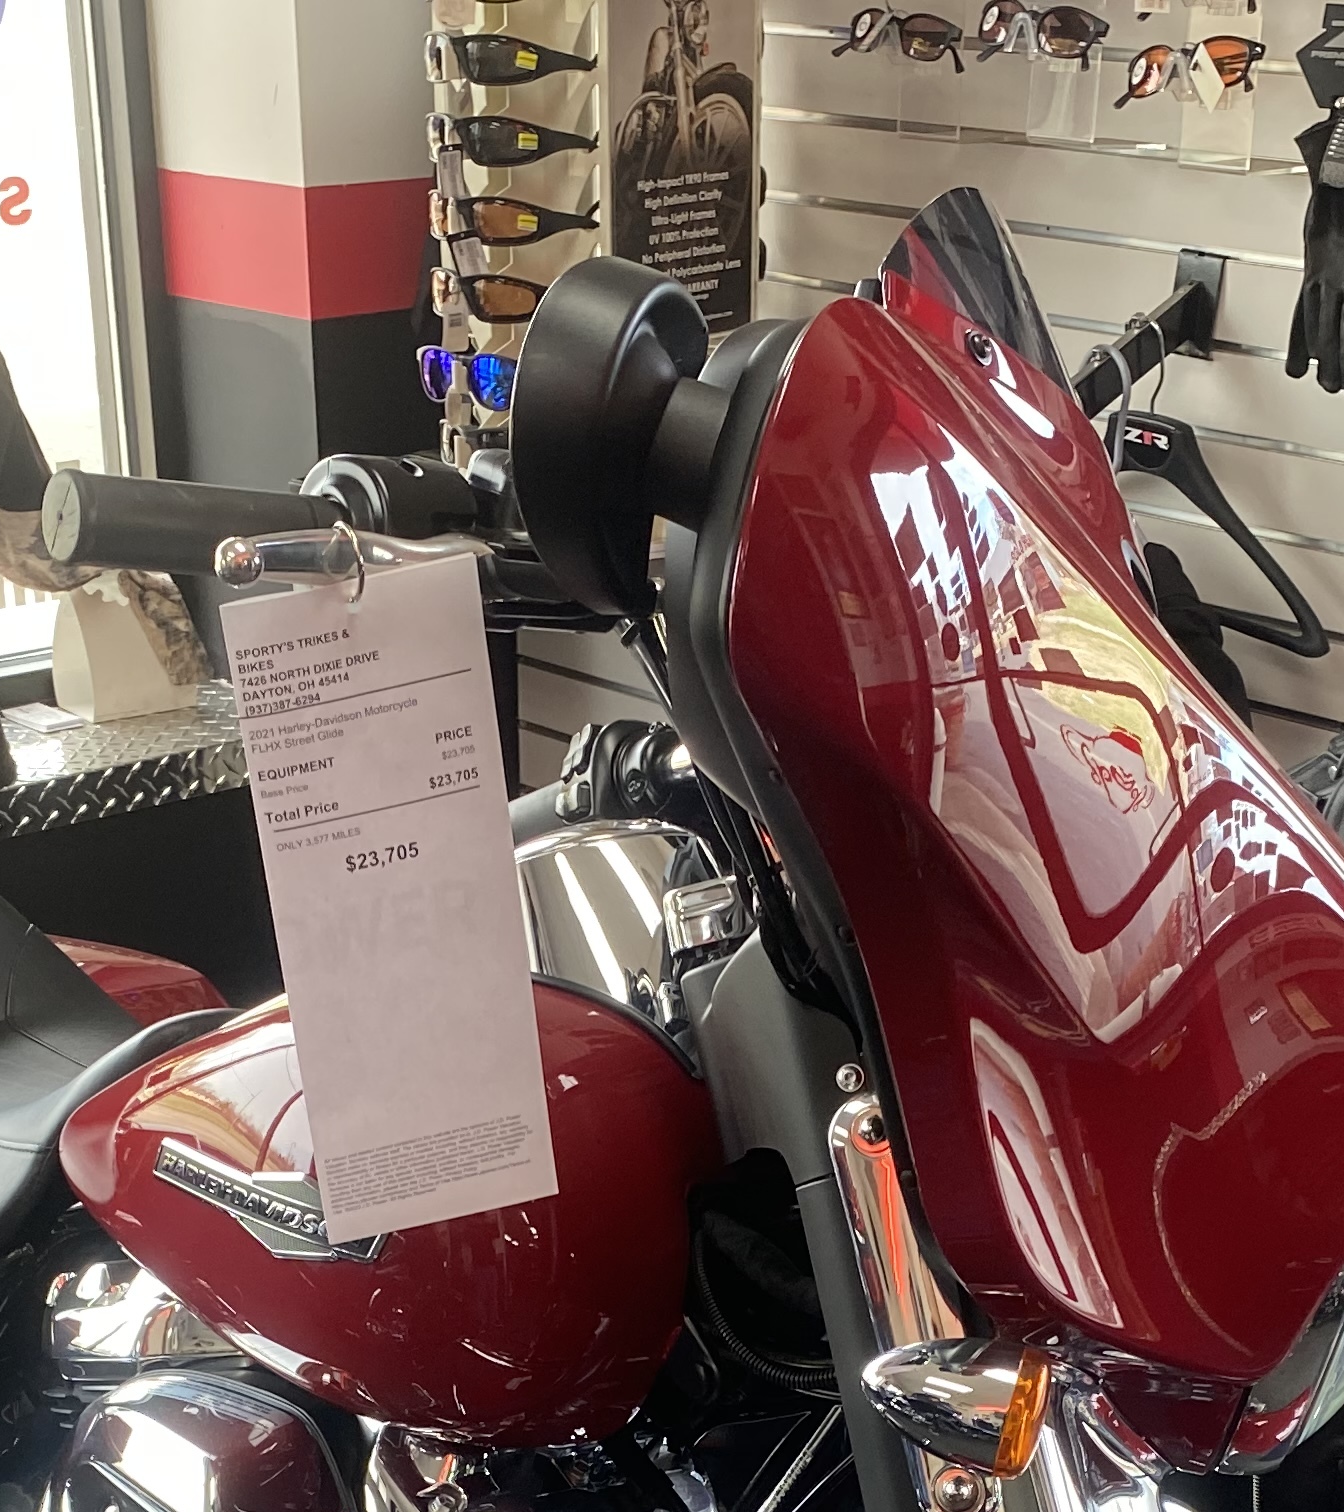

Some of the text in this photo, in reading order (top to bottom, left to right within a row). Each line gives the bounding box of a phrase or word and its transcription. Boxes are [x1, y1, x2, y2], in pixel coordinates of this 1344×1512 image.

[235, 628, 350, 660] SPORTY'S TRIKES &
[238, 659, 274, 675] BIKES
[240, 650, 380, 688] 7426 NORTH DIXIE DRIVE
[242, 672, 350, 702] DAYTON, OH 45414
[244, 692, 321, 717] (937)387-6294
[248, 697, 418, 741] 2021 Harley-Davidson Motorcycle
[251, 727, 345, 754] FLHX Street Glide
[258, 725, 473, 782] EQUIPMENT PRICE
[260, 744, 476, 799] Base Price $23,705
[264, 766, 480, 825] Total Price $23,705
[276, 839, 303, 852] ONLY
[332, 826, 361, 842] MILES
[345, 841, 420, 873] $23,705
